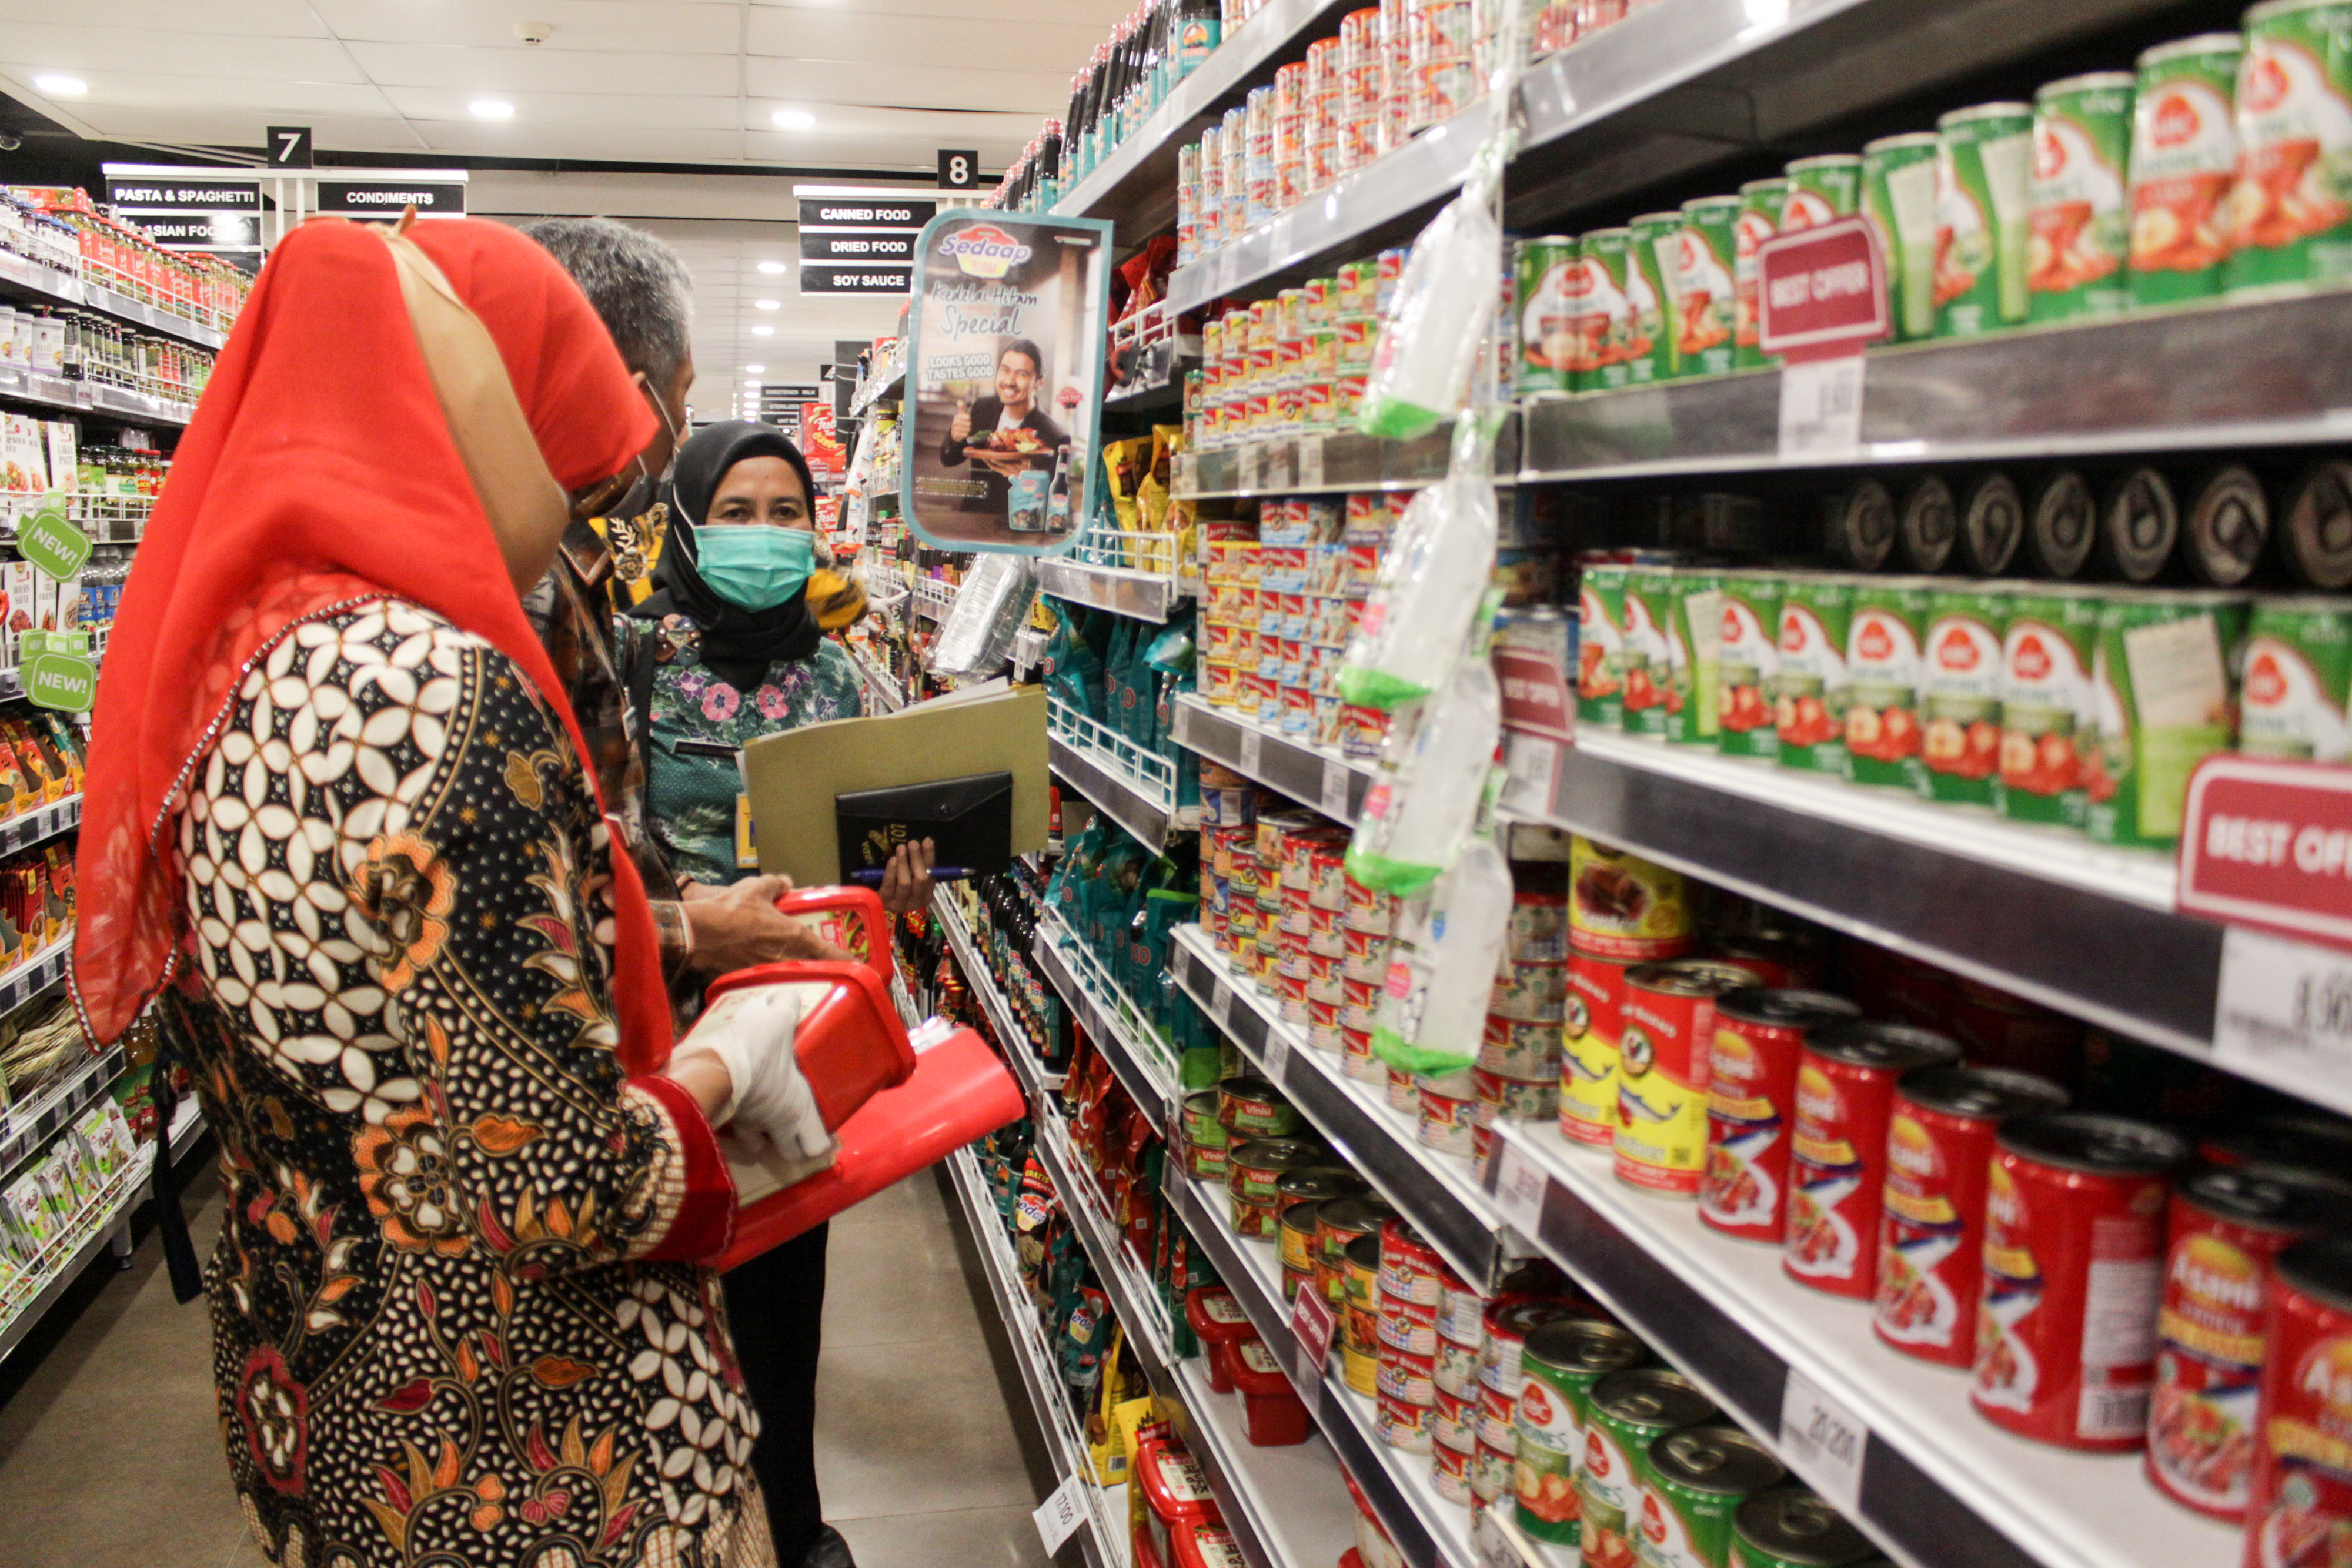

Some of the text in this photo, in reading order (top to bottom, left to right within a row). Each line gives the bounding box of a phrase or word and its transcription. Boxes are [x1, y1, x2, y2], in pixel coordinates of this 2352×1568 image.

[278, 133, 302, 163] 7
[948, 156, 968, 185] 8
[115, 188, 255, 203] PASTA & SPAGHETTI
[346, 192, 434, 206] CONDIMENTS
[820, 208, 911, 221] CANNED FOOD
[830, 240, 908, 253] DRIED FOOD
[940, 236, 1031, 265] Sedaap
[833, 275, 905, 286] SOY SAUCE
[931, 281, 1038, 305] Kedelai Hitam
[940, 305, 1022, 341] Special
[929, 353, 991, 369] LOOKS GOOD
[926, 365, 994, 381] TASTES GOOD
[32, 526, 78, 566] NEW!
[38, 670, 88, 694] NEW!
[2206, 815, 2293, 865] BEST
[1024, 1169, 1050, 1183] GRATIS
